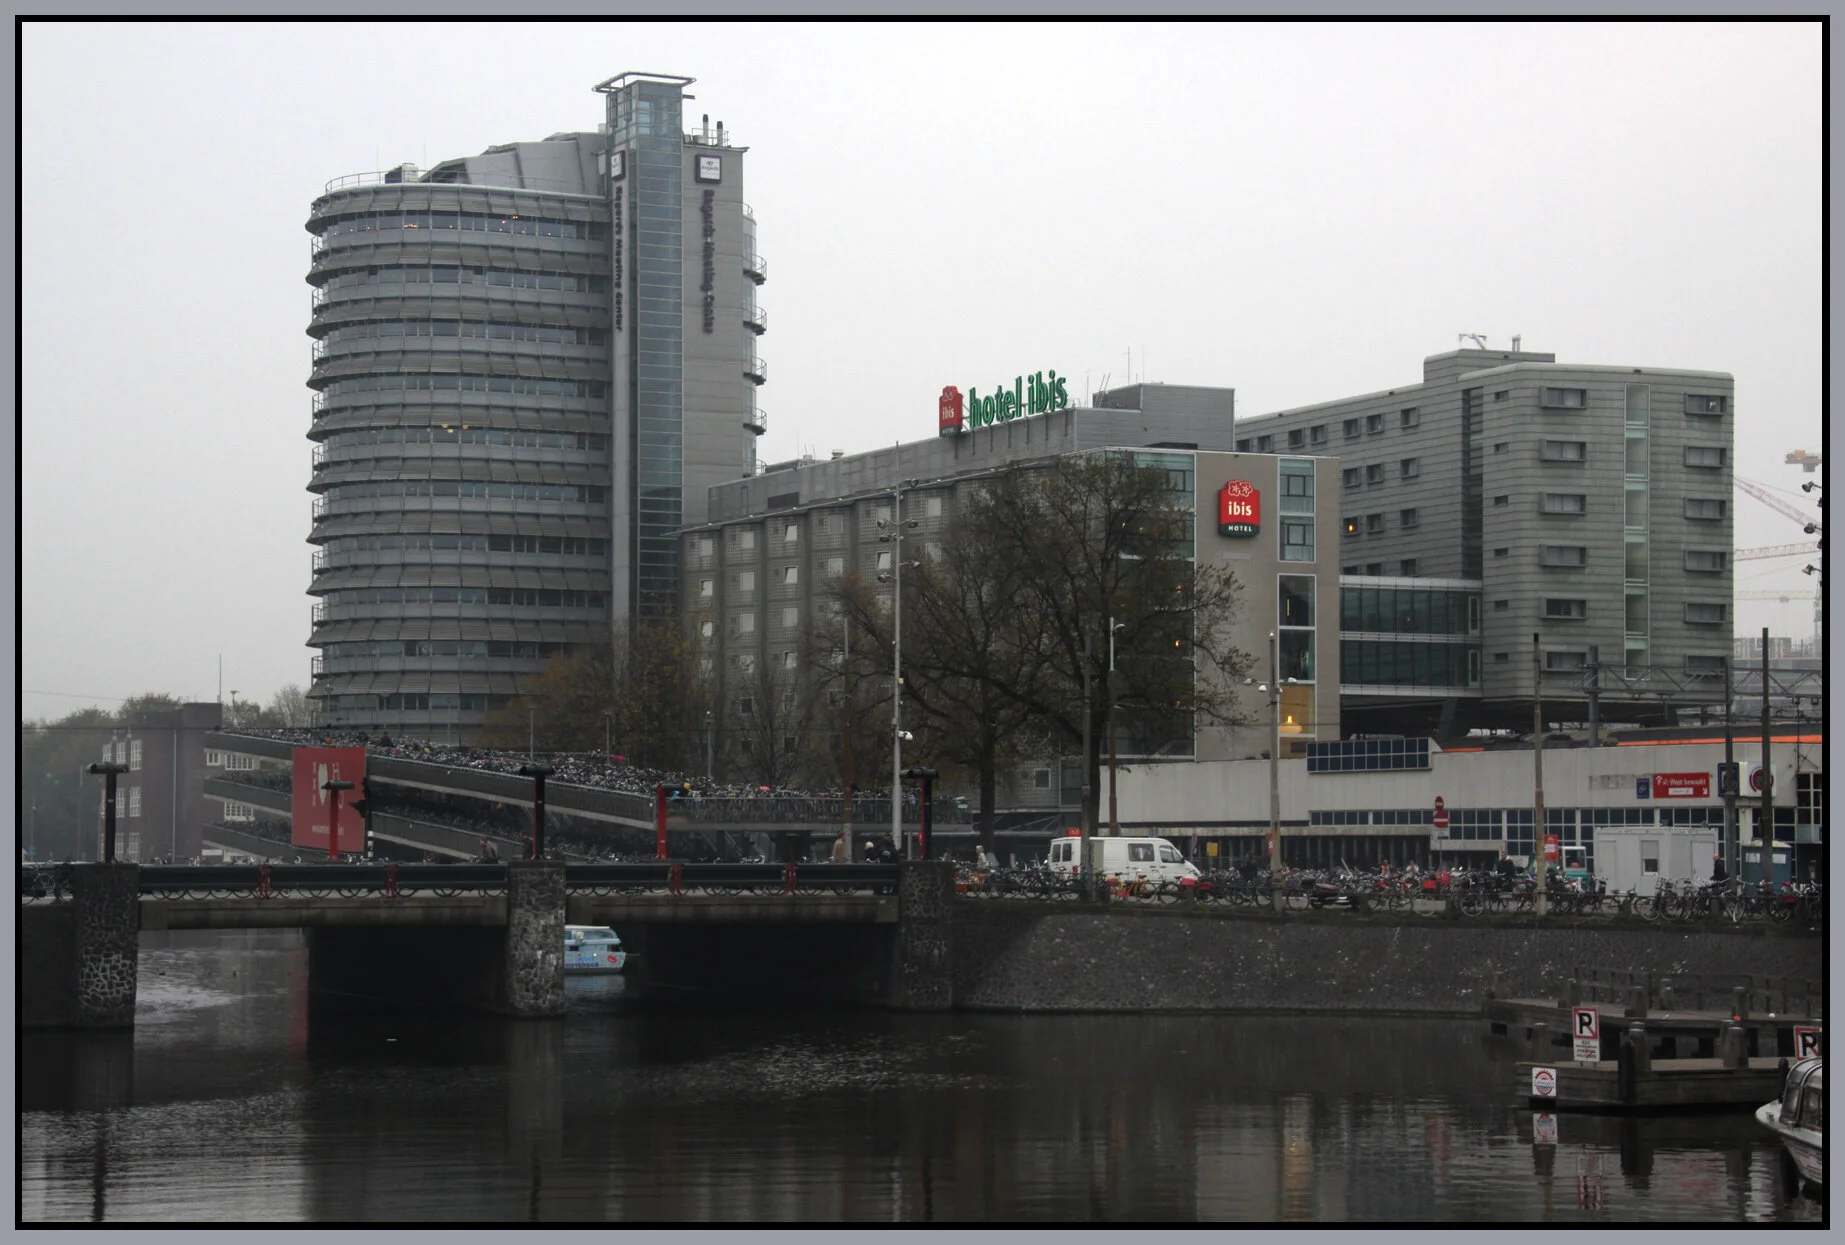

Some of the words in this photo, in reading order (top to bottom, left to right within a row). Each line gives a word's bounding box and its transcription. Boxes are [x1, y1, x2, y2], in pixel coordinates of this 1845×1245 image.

[969, 375, 1023, 429] hotel
[1028, 369, 1068, 415] ibis
[942, 406, 955, 420] ibis
[1228, 501, 1252, 516] ibis
